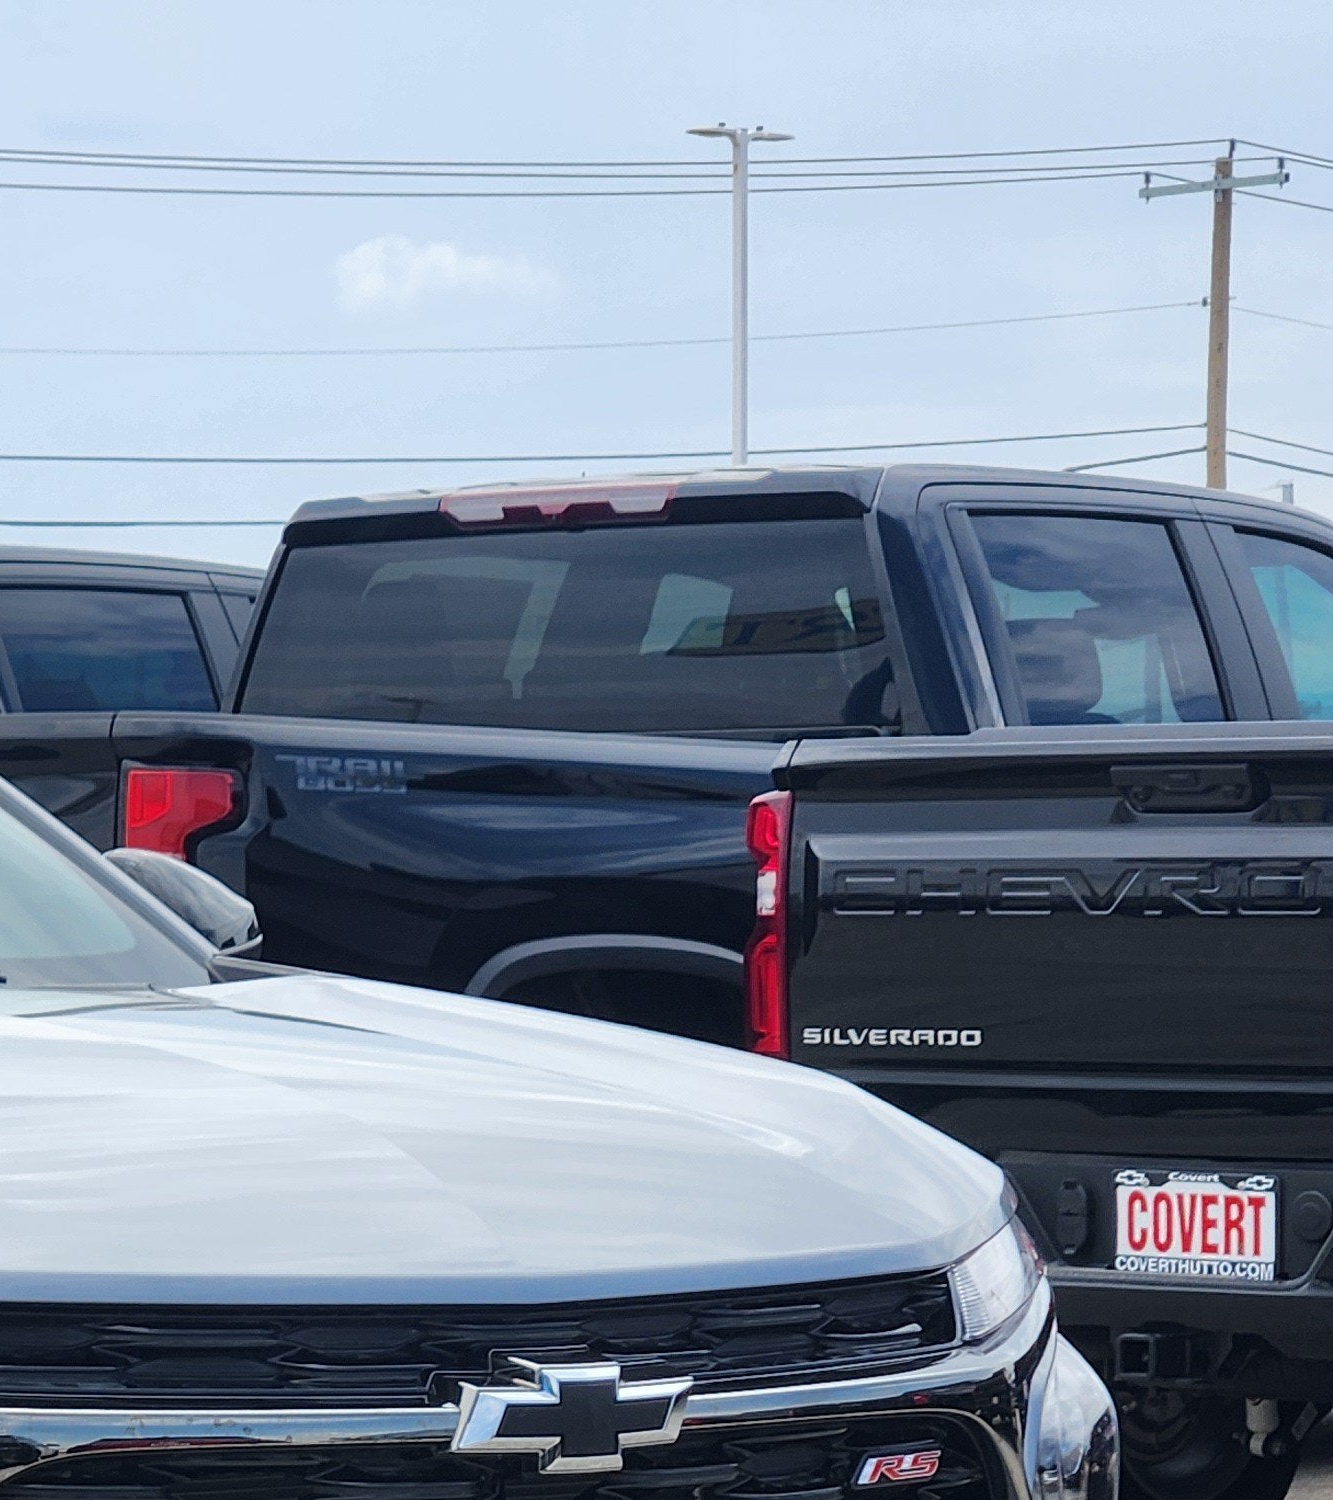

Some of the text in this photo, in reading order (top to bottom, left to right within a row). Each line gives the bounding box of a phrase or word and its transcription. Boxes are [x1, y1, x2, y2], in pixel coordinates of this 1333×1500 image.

[275, 754, 405, 777] TRAIL
[802, 1027, 982, 1046] SILVERADO
[1168, 1171, 1220, 1183] Covert
[1127, 1190, 1266, 1257] COVERT
[1114, 1256, 1274, 1281] COVERTHUTTO.COM
[859, 1449, 941, 1484] RS
